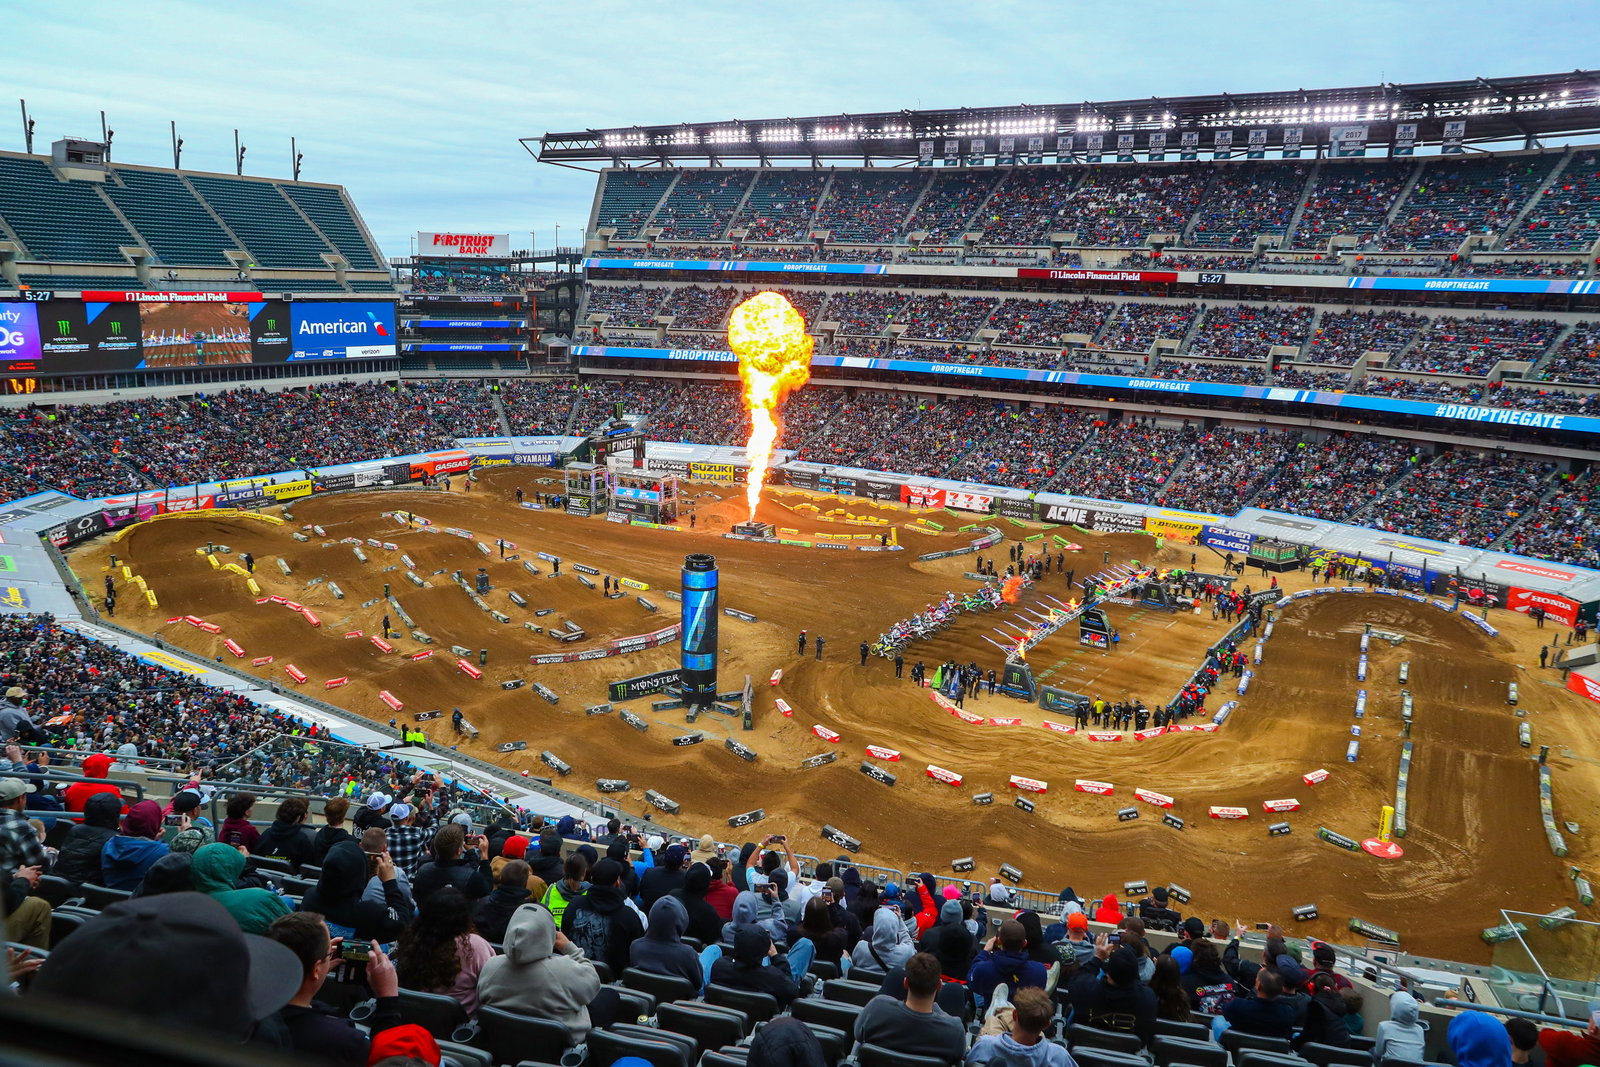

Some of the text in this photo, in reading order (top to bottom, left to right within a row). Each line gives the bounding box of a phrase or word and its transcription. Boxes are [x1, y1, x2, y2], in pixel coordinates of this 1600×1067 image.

[1345, 131, 1362, 139] 2017
[1398, 131, 1414, 139] 2019
[460, 246, 488, 254] BANK
[1058, 271, 1140, 281] Lincoln Financial Field
[1202, 275, 1222, 283] 5:27
[1425, 281, 1490, 290] #DROPTHEGATE
[25, 291, 50, 301] 5:27
[135, 292, 228, 301] Lincoln Financial Field
[299, 319, 367, 335] American
[668, 350, 738, 362] #DROPTHEGA
[931, 365, 983, 375] #DROPTHEGATE
[1129, 379, 1190, 391] #DROPTHEGATE
[1435, 404, 1564, 429] #DROPTHEGATE
[612, 437, 637, 452] FINISH
[522, 454, 552, 463] YAMAHA
[435, 460, 468, 471] GASGAS
[691, 464, 732, 472] SUZUKI
[691, 472, 732, 480] SUZUKI
[273, 484, 310, 495] DUNLOP
[216, 489, 264, 502] FALKEN
[1003, 499, 1032, 508] MONSTER
[1002, 509, 1031, 518] MONSTER
[1157, 521, 1199, 531] DUNLOP
[1209, 527, 1251, 539] FALKEN
[1207, 537, 1250, 550] FALKEN
[1516, 566, 1570, 580] HONDA
[623, 580, 643, 590] SUZUKI
[1532, 595, 1572, 610] HONDA
[631, 673, 680, 691] MONSTER
